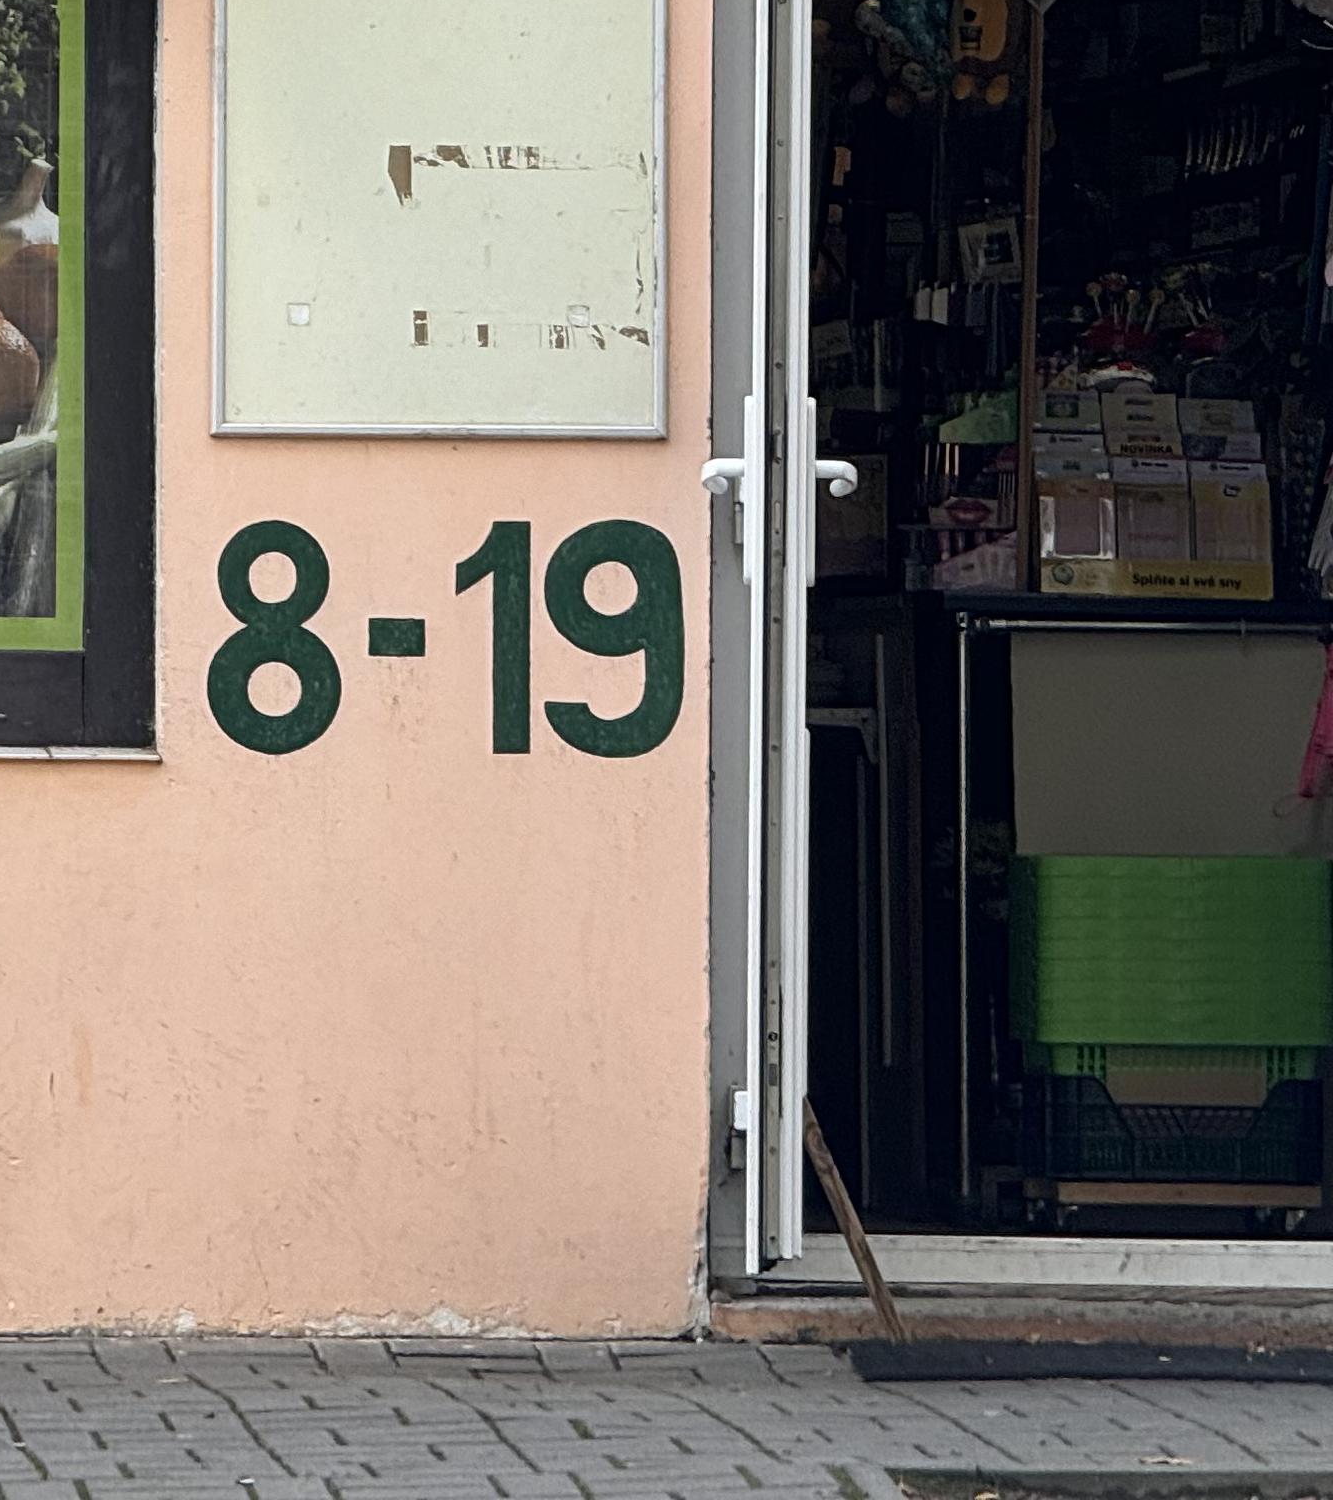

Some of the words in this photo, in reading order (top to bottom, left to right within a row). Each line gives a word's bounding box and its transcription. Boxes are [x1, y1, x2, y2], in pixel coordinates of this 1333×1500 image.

[1120, 443, 1173, 454] NOVINKA
[1179, 574, 1190, 586] si
[1219, 578, 1242, 591] sny
[206, 519, 686, 759] 8-19
